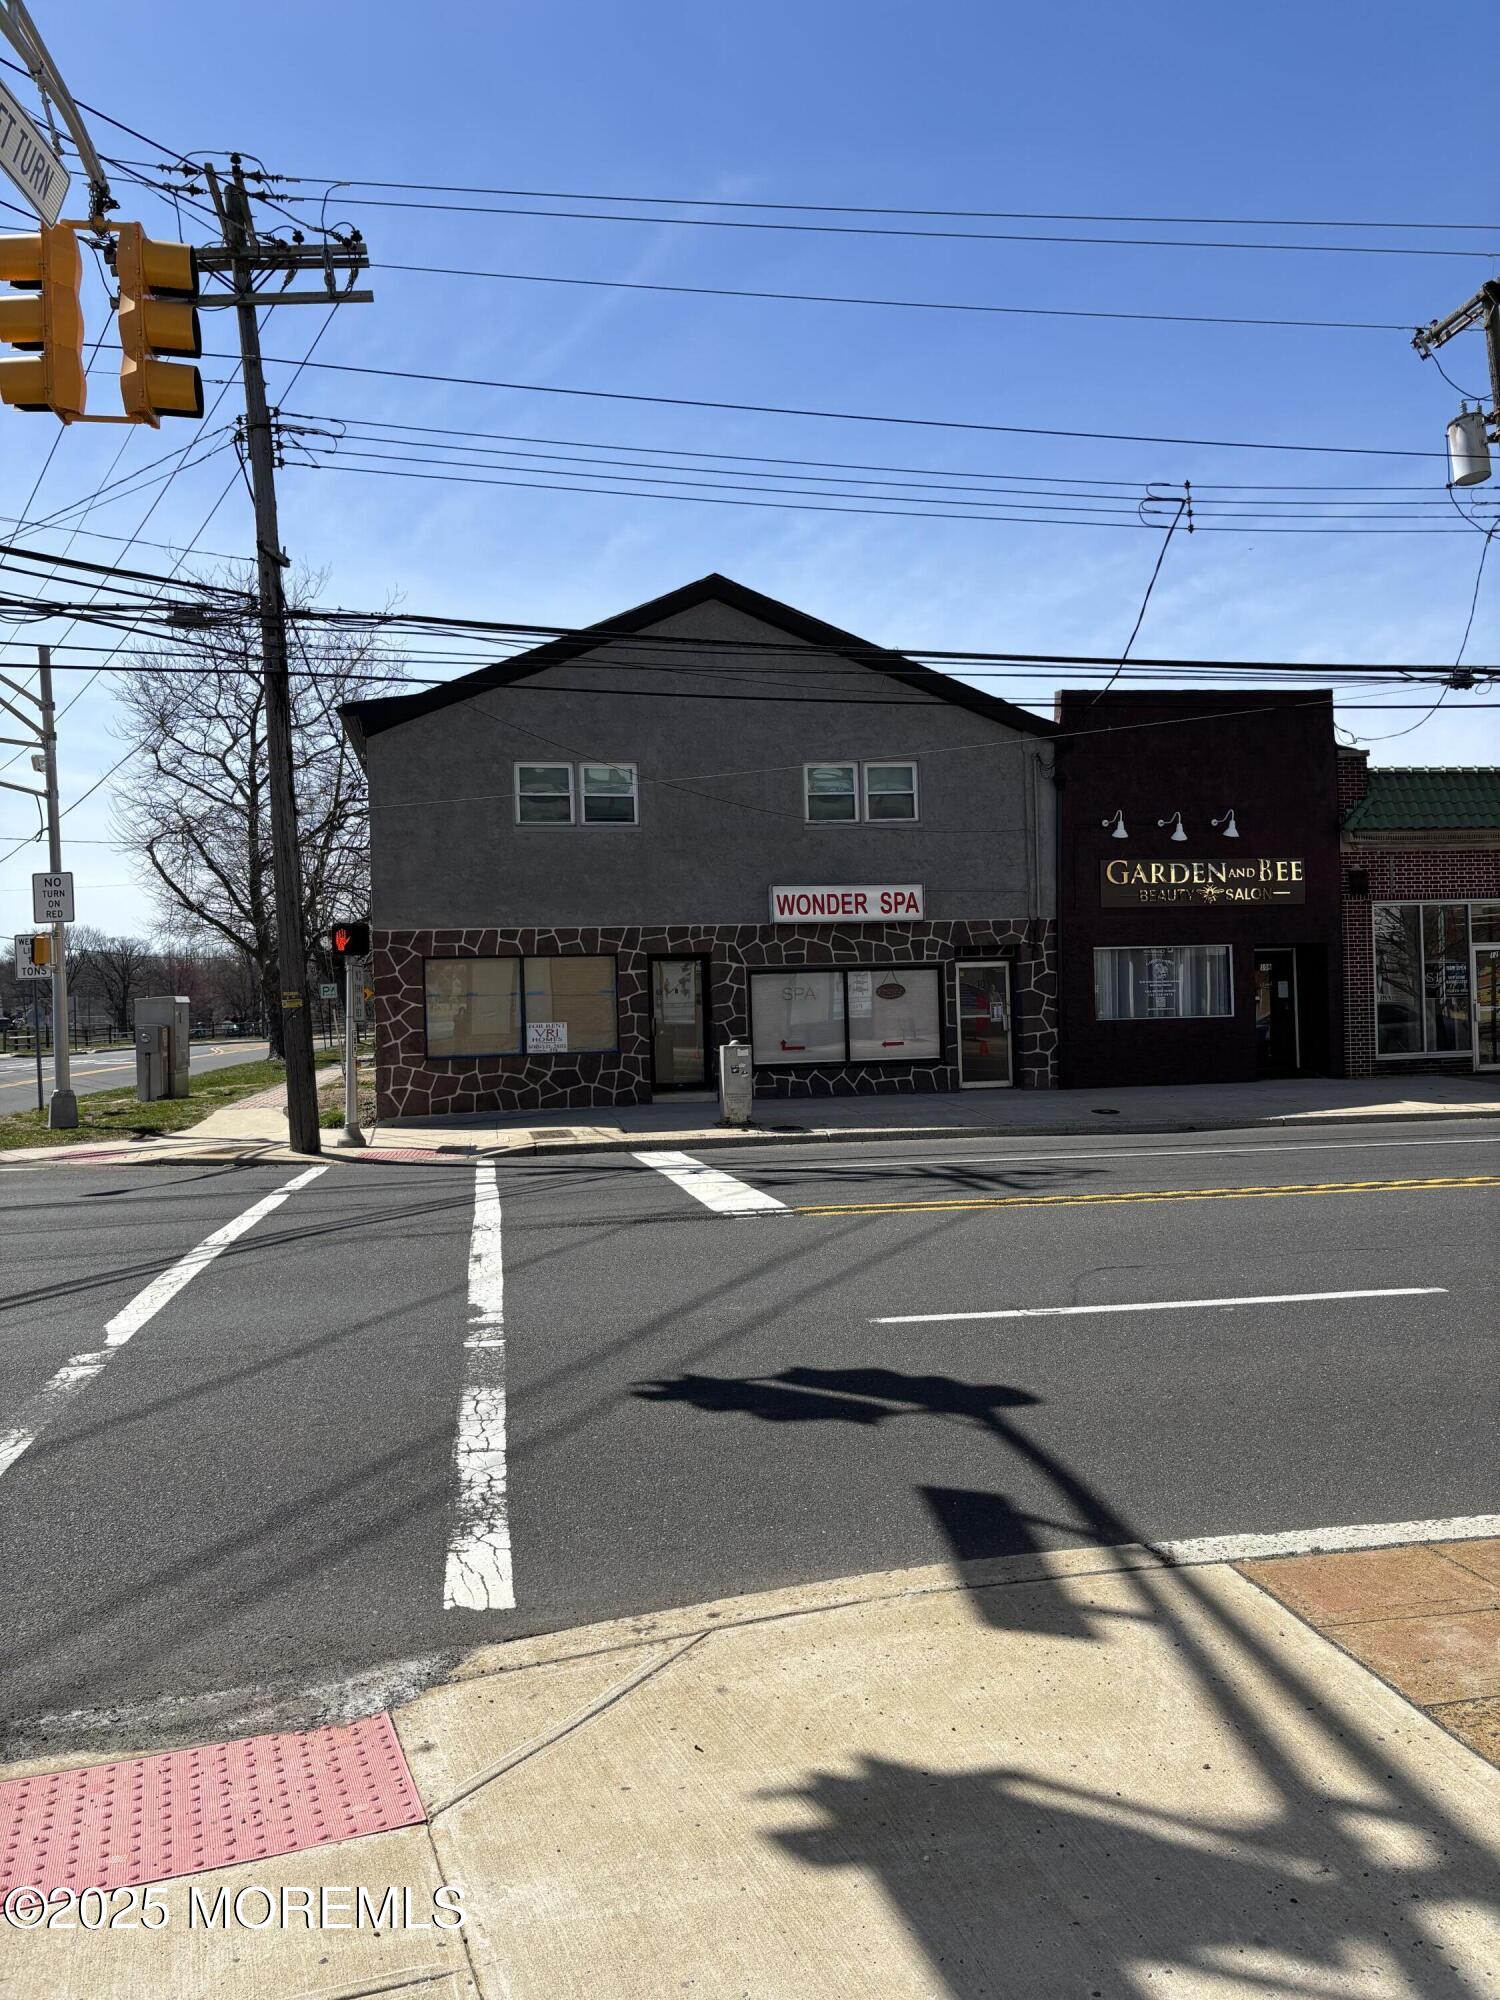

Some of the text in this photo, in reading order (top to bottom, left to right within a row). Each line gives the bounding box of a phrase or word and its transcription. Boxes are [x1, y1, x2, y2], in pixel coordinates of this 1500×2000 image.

[13, 128, 54, 200] TURN
[1106, 858, 1303, 884] GARDEN AND BEE
[44, 878, 61, 887] NO
[43, 890, 65, 898] TURN
[1139, 887, 1272, 902] BEAUTY SALON
[48, 900, 60, 908] ON
[776, 891, 920, 915] WONDER SPA
[46, 910, 63, 918] RED
[21, 967, 47, 976] TONS
[782, 986, 817, 1001] SPA
